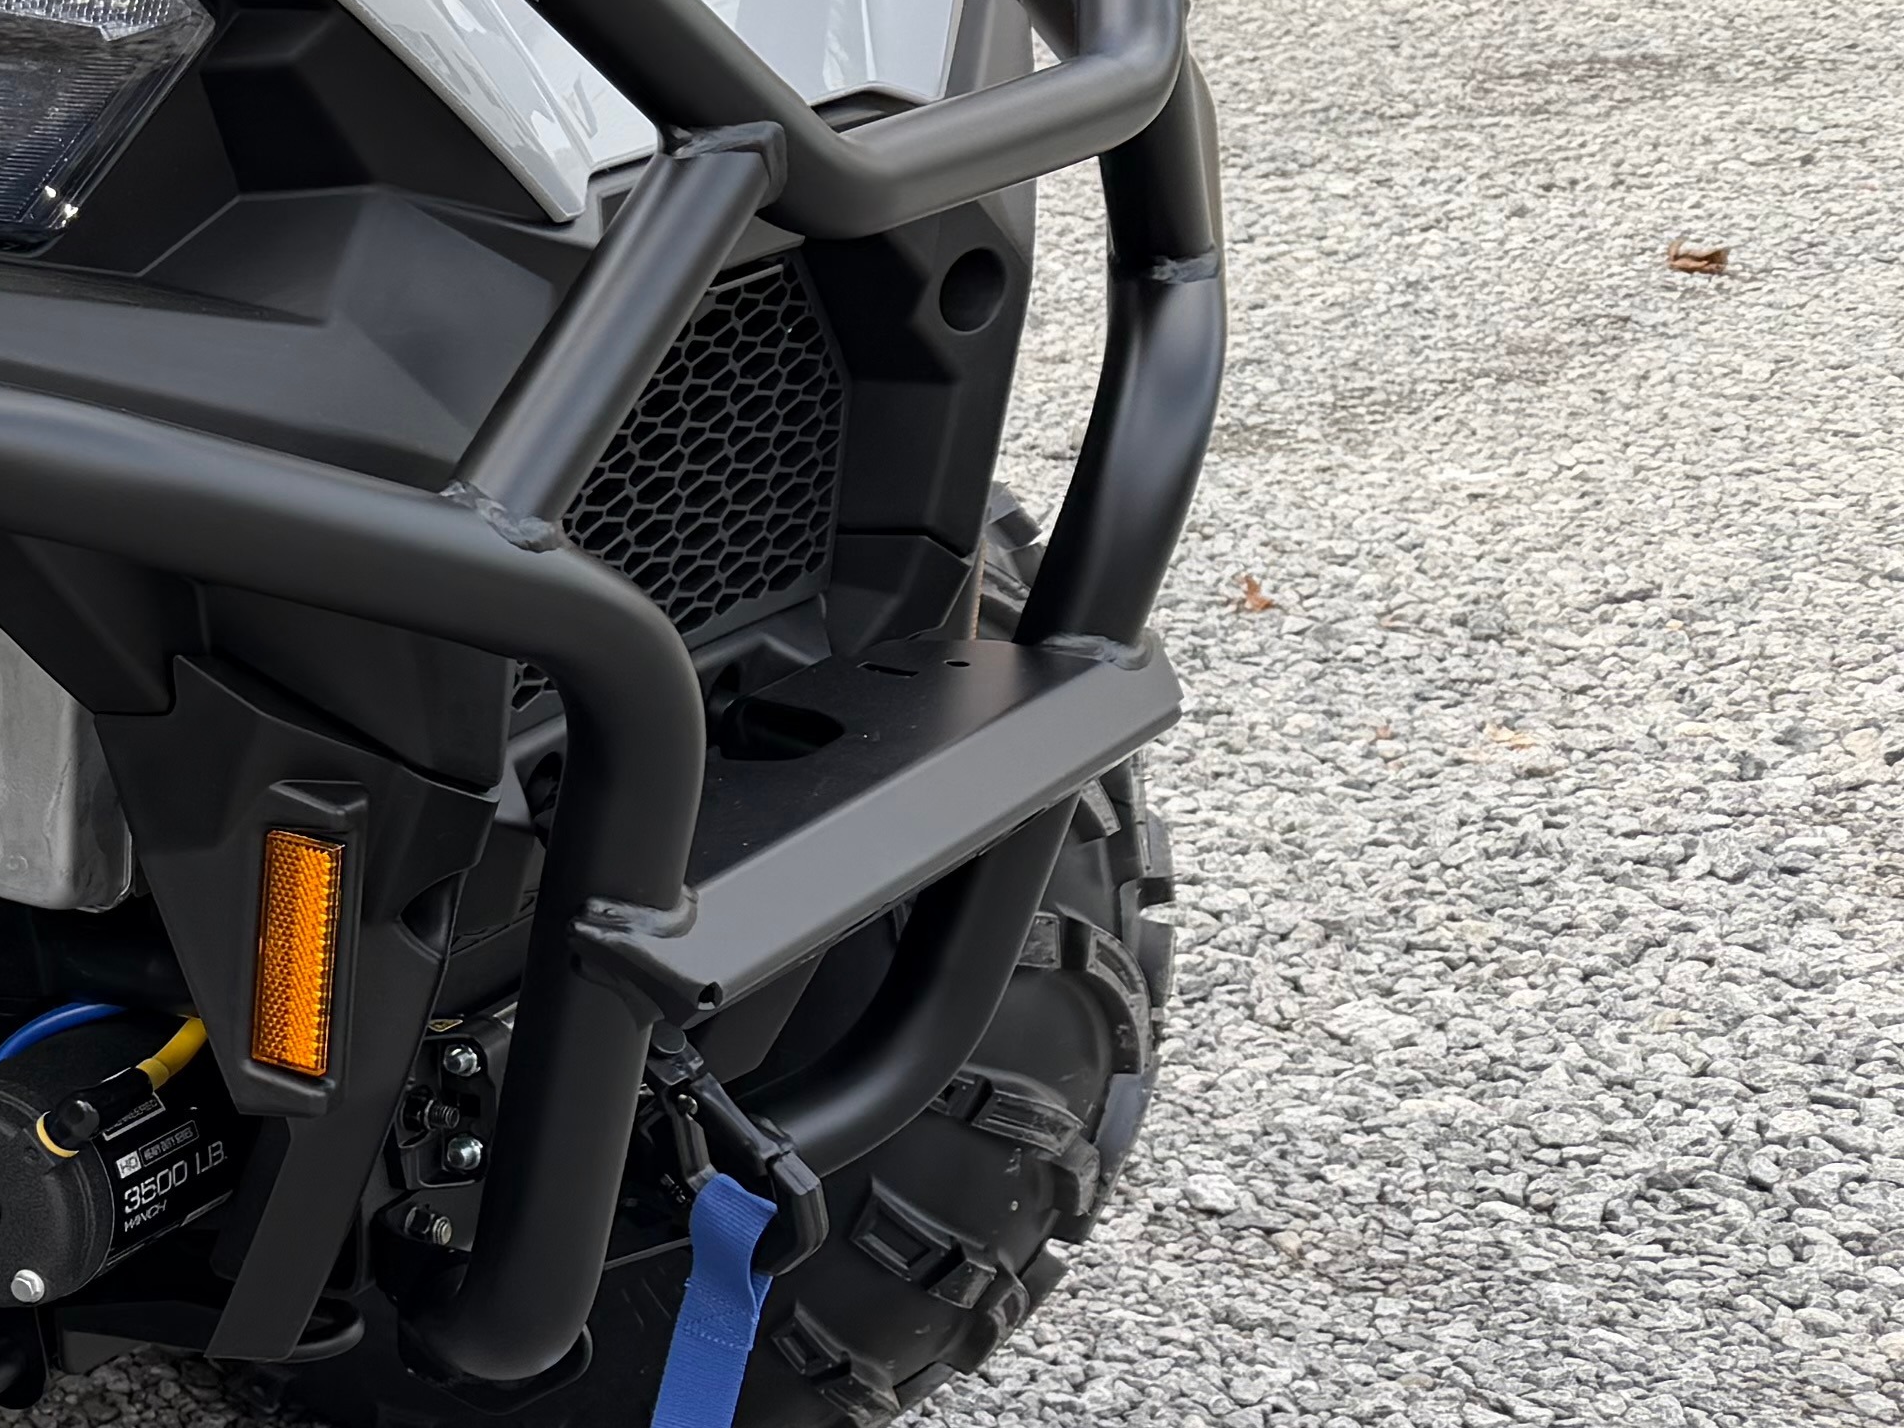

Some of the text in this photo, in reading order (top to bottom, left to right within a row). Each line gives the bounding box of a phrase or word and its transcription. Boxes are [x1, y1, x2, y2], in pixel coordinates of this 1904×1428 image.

[124, 1140, 228, 1214] 3500 LB.
[124, 1199, 168, 1233] WINCH
